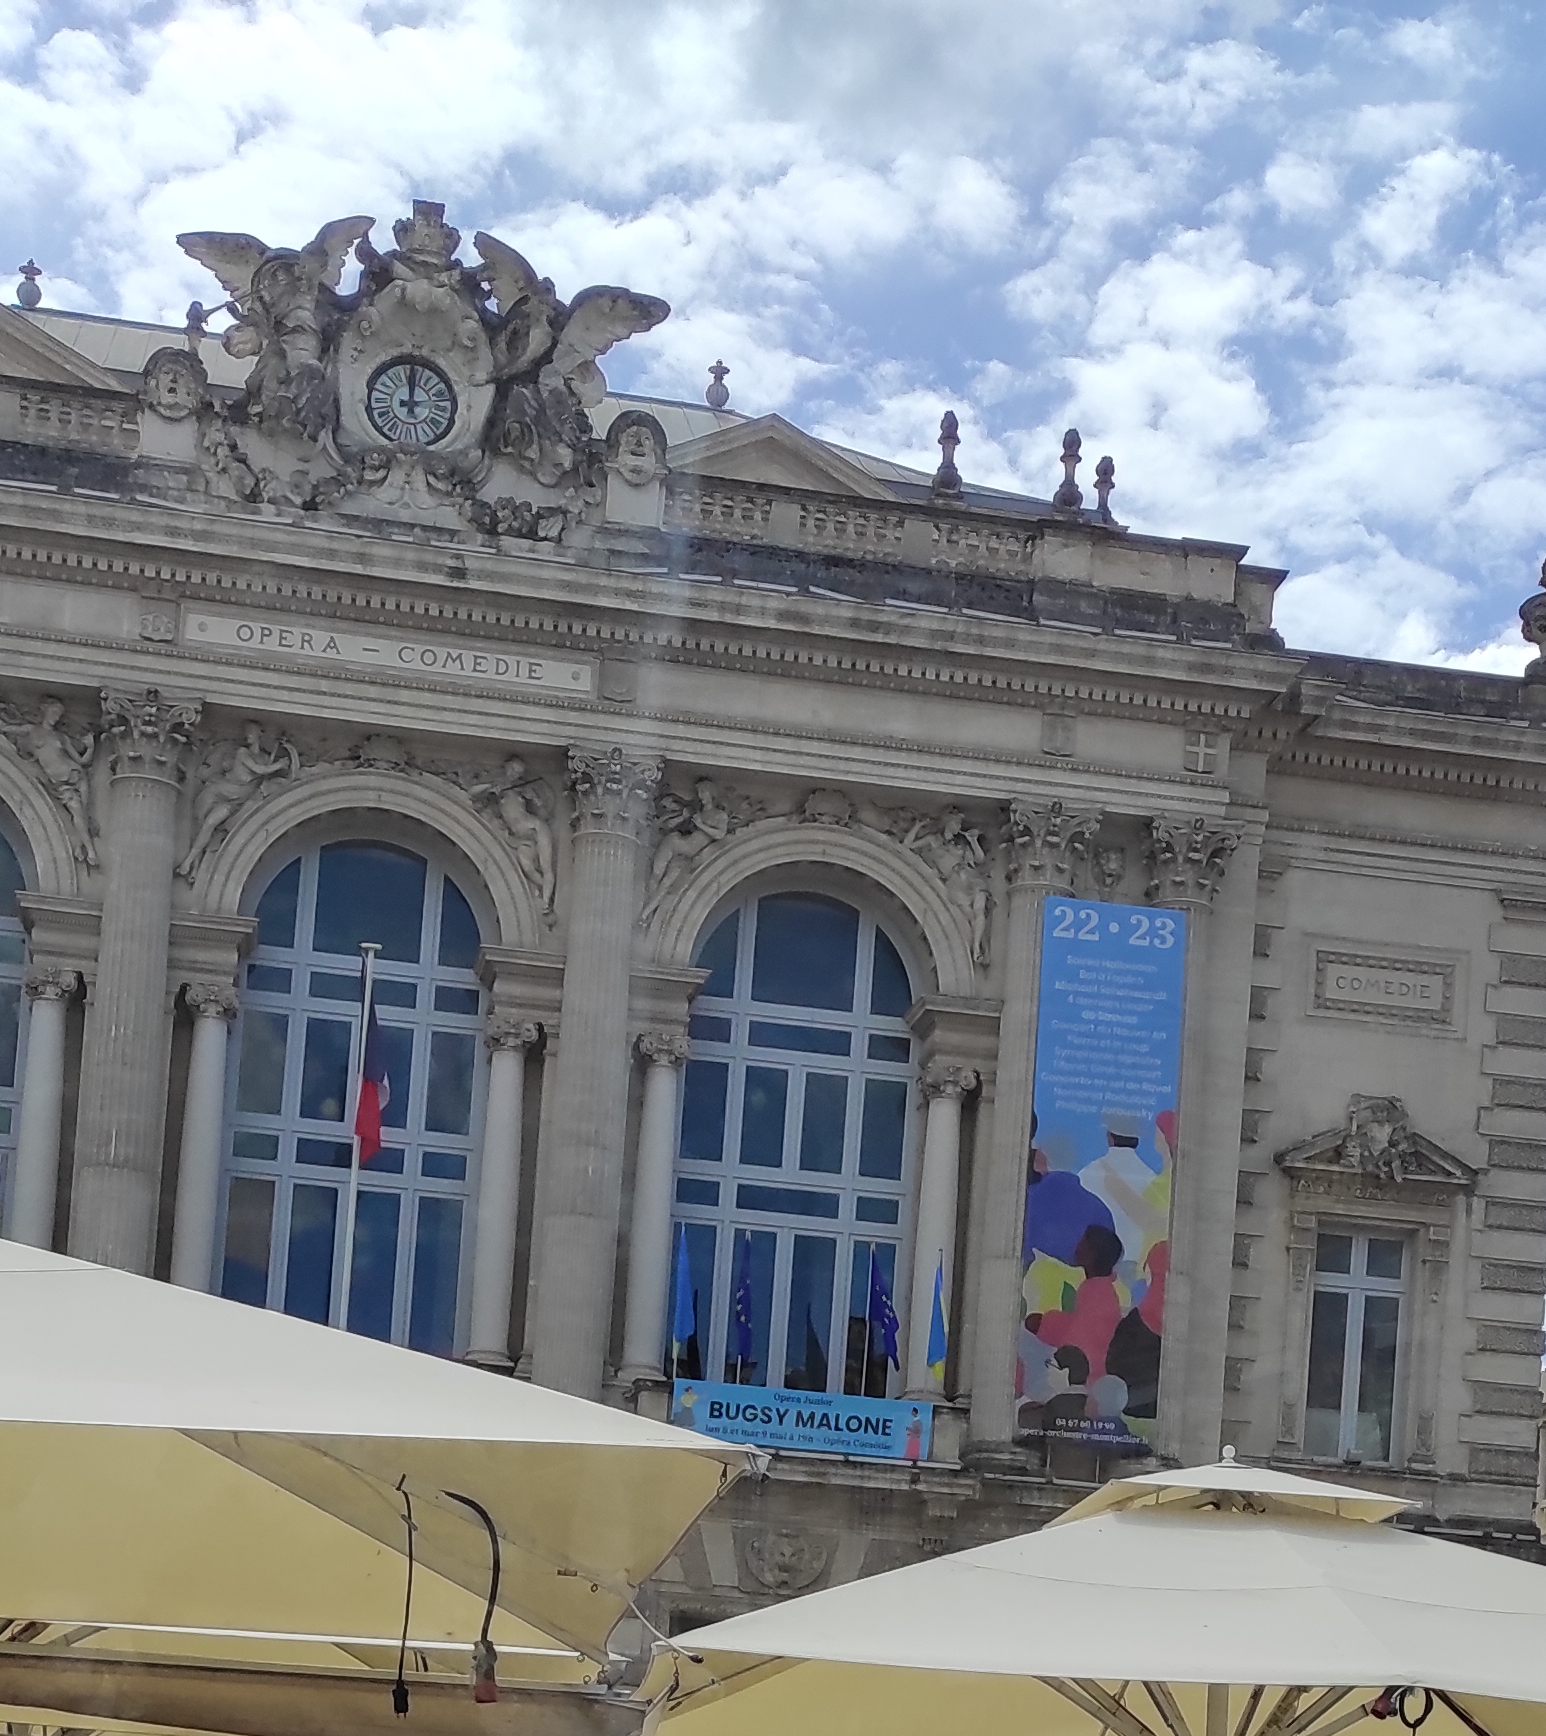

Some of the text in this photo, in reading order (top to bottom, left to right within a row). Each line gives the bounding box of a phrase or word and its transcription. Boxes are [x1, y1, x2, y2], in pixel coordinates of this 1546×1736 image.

[235, 623, 342, 655] OPERA
[397, 645, 545, 681] COMEDIE
[1052, 906, 1100, 941] 22
[1128, 914, 1176, 949] 23
[1334, 974, 1433, 1000] COMEDIE
[708, 1400, 894, 1437] BUGSY MALONE
